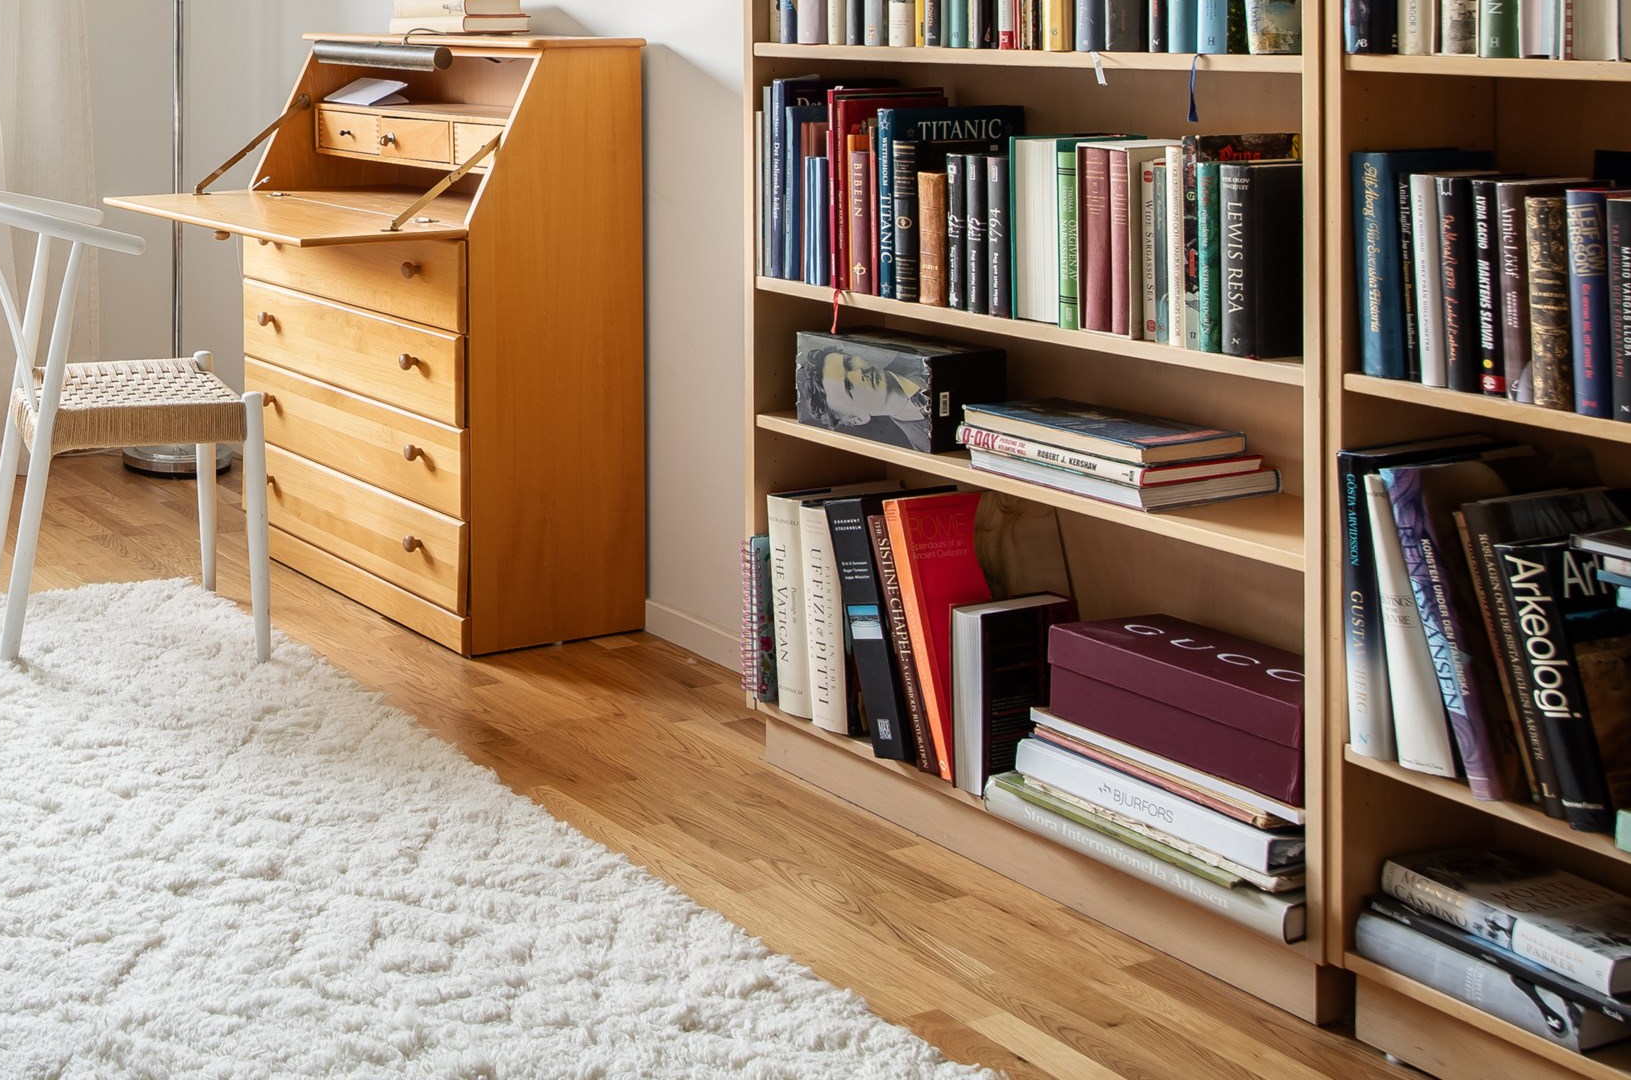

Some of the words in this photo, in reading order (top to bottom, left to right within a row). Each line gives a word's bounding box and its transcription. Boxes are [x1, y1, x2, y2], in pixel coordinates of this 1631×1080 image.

[918, 119, 1002, 141] TITANIC
[853, 163, 863, 218] BIBELN
[1223, 183, 1249, 191] ENQUIST
[1398, 183, 1409, 205] Anita
[1145, 200, 1153, 226] WIDE
[1399, 206, 1411, 235] Haglöf
[1442, 215, 1455, 231] The
[1475, 195, 1487, 220] LYDIA
[1501, 203, 1517, 243] Annie
[1575, 207, 1601, 240] LEIF
[880, 193, 893, 264] TITANIC
[948, 212, 965, 238] 1795
[967, 214, 987, 242] 1795
[989, 208, 1003, 244] 1794
[1227, 201, 1244, 260] LEWIS
[1476, 221, 1489, 250] CACHO
[1567, 208, 1591, 274] PERSSON
[1060, 218, 1068, 281] NARCISSISTER
[1067, 219, 1077, 266] OMGIVEN
[1145, 231, 1153, 280] SARGASSO
[1585, 243, 1607, 272] GW
[1067, 267, 1077, 281] AV
[1202, 263, 1210, 291] ASTRID
[1442, 257, 1459, 290] Room
[1503, 245, 1520, 279] Lööf
[1612, 252, 1622, 281] JULIA
[1621, 246, 1630, 278] MARIO
[1227, 267, 1244, 314] RESA
[1477, 259, 1492, 309] MAKTENS
[1613, 285, 1623, 305] OCH
[1202, 293, 1210, 334] LINDGREN
[1622, 282, 1631, 321] VARGAS
[1190, 331, 1196, 339] 17
[1479, 309, 1494, 350] SLAVAR
[1623, 324, 1631, 356] LLOSA
[961, 426, 999, 450] D-DAY
[997, 443, 1016, 454] ATLANTIC
[1037, 449, 1060, 462] ROBERT
[1060, 454, 1067, 463] J.
[1068, 457, 1098, 471] KERSHAW
[1346, 473, 1358, 506] GÖSTA
[910, 541, 948, 552] Splendours
[1347, 509, 1359, 566] ARVIDSSON
[775, 544, 786, 580] THE
[912, 550, 936, 560] Ancient
[1420, 538, 1439, 582] KONSTEN
[1477, 533, 1501, 590] ROSLAGEN
[810, 548, 825, 624] UFFIZI
[825, 565, 834, 636] PAINTINGS
[1433, 584, 1448, 617] UNDER
[1494, 592, 1508, 616] OCH
[776, 586, 789, 663] VATICAN
[1443, 619, 1454, 639] DEN
[1500, 617, 1511, 633] DE
[1503, 554, 1582, 719] Arkeologi
[829, 644, 835, 658] IN
[877, 537, 899, 595] SISTINE
[889, 597, 911, 662] CHAPEL:
[904, 671, 917, 712] GLORIOUS
[912, 713, 929, 769] RESTORATION
[1124, 624, 1305, 682] GUCC
[1350, 590, 1368, 714] GUSTAVSBERG
[1504, 633, 1520, 663] SISTA
[815, 641, 829, 705] PITTI
[1448, 640, 1470, 696] ITALIENSKA
[1511, 664, 1530, 709] SEGLEN
[1113, 788, 1174, 824] BJURFORS
[1023, 806, 1058, 833] Stora
[1061, 823, 1168, 882] Internationella
[1170, 874, 1229, 909] Atlasen
[1394, 884, 1467, 928] CASSINO
[1526, 943, 1577, 974] PARKER
